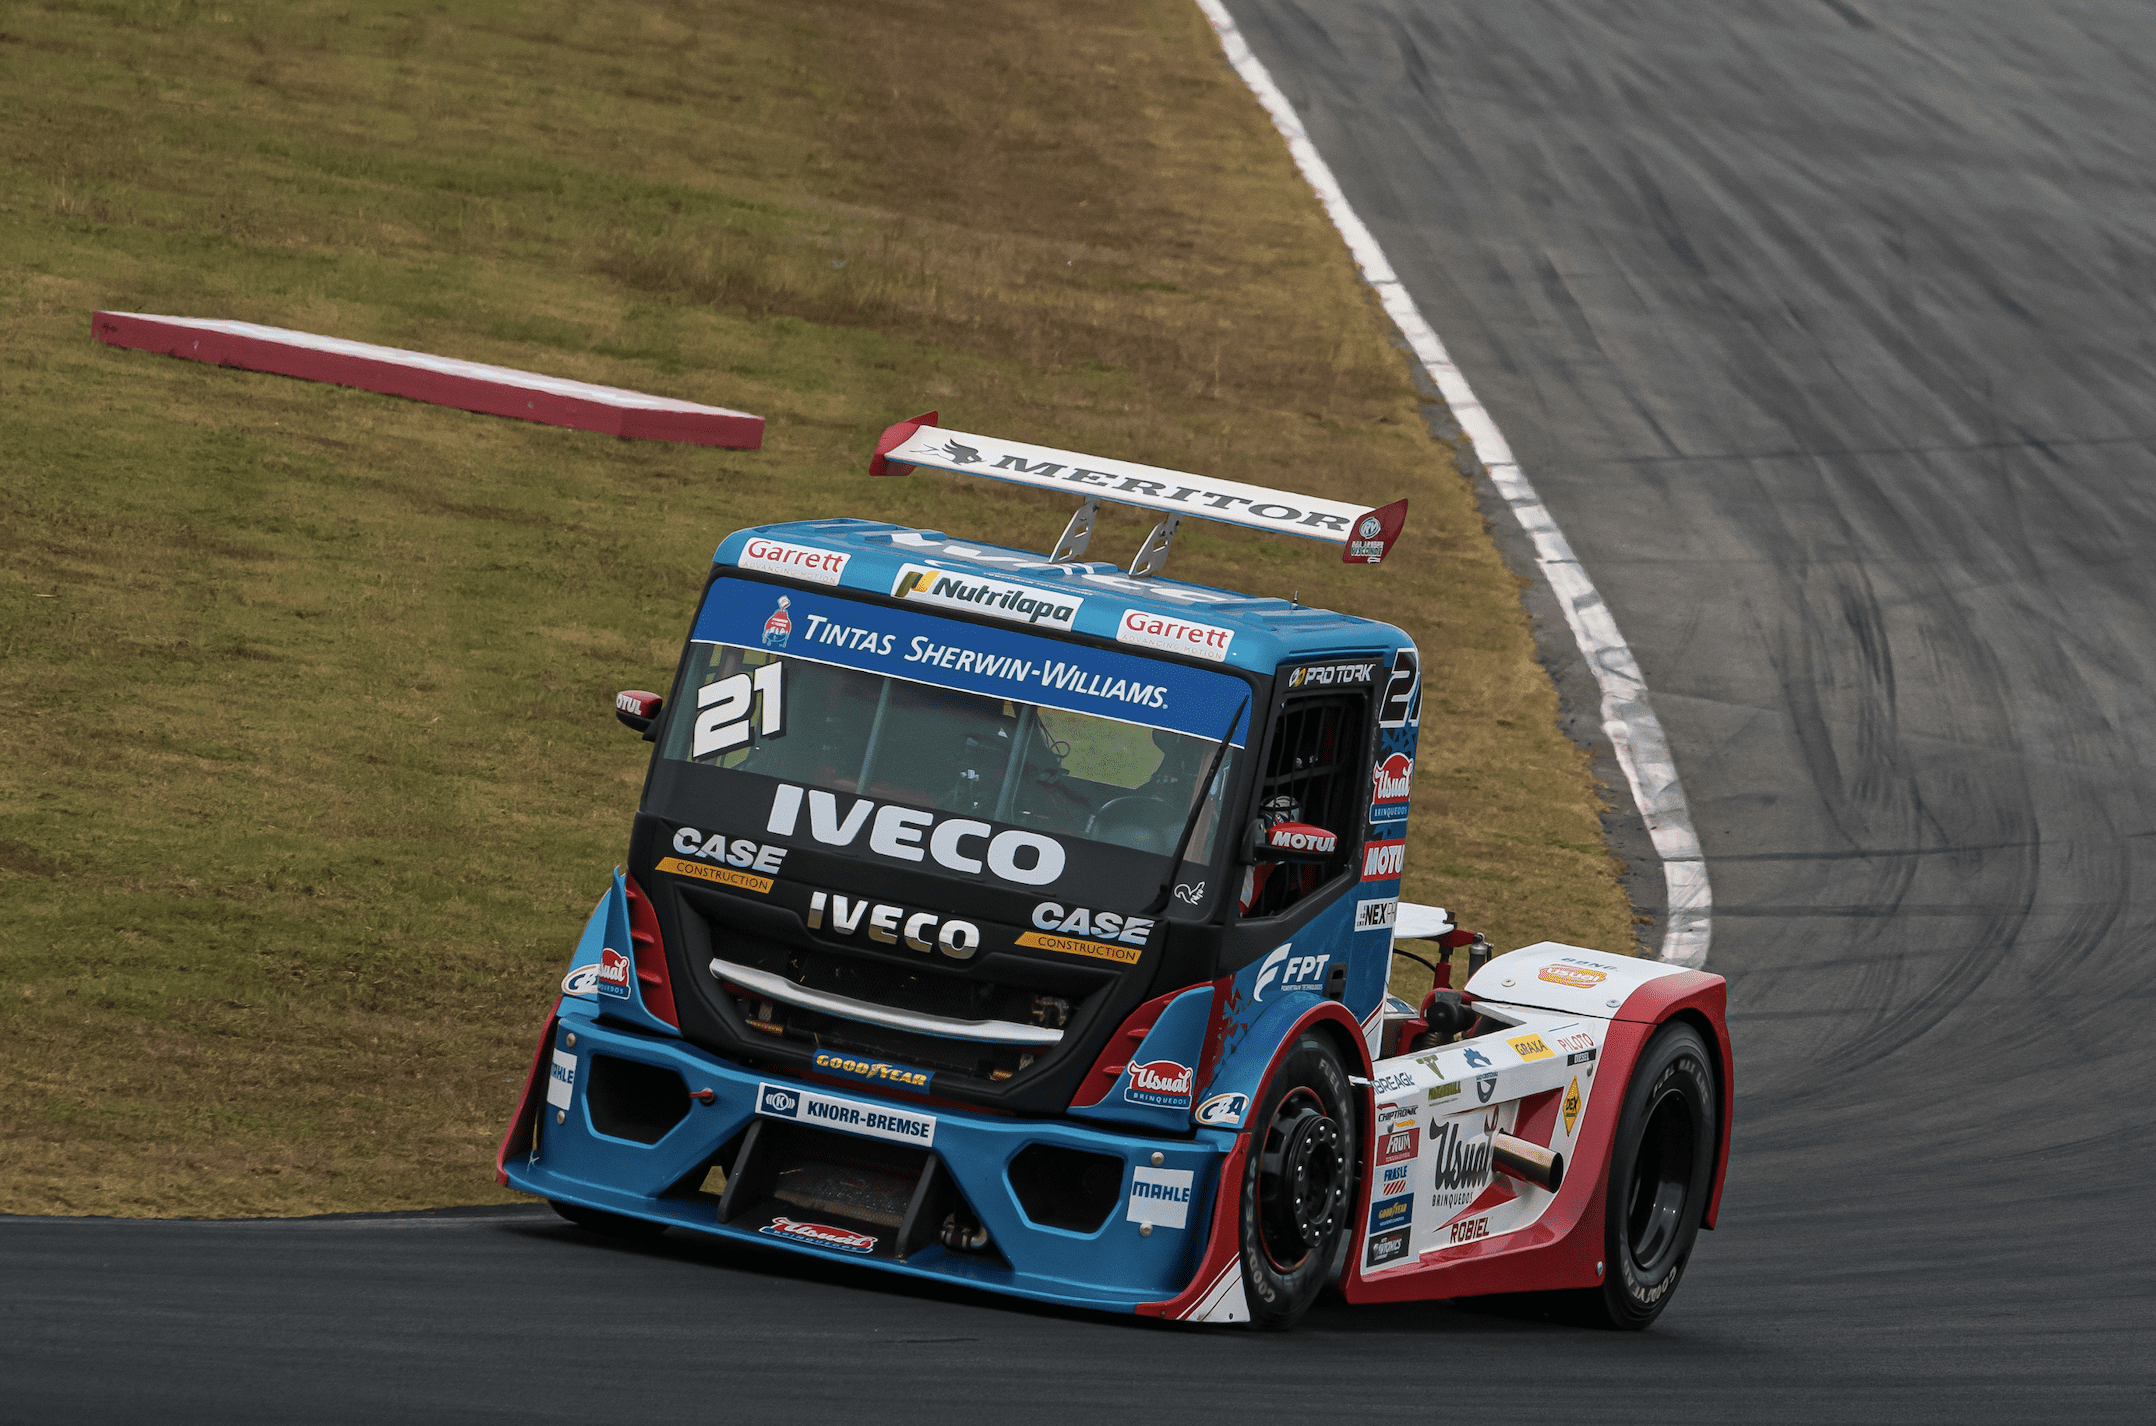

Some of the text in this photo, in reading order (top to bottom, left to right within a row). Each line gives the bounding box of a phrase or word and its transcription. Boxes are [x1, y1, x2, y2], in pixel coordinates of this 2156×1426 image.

[990, 455, 1350, 532] MERITOR
[743, 561, 836, 583] ADVANCING MOTION
[748, 541, 843, 573] Garrett
[932, 577, 1074, 624] Nutrilapa
[804, 614, 896, 655] TINTAS
[1126, 613, 1228, 649] Garrett
[1122, 634, 1223, 660] ADVANCING MOTION
[1304, 664, 1376, 685] PRO TORK
[616, 693, 642, 716] OTUL
[693, 661, 782, 758] 21
[1374, 761, 1413, 799] Usual
[766, 783, 1066, 886] IVECO
[1271, 830, 1335, 852] MOTUL
[672, 827, 788, 875] CASE
[1364, 844, 1405, 876] MOTU
[676, 862, 769, 890] CONSTRUCTION
[806, 891, 980, 959] IVECO
[1031, 902, 1155, 945] CASE
[1037, 936, 1136, 962] CONSTRUCTION
[1282, 954, 1331, 984] FPT
[1515, 1040, 1549, 1056] GRAXA
[1557, 1033, 1595, 1052] PILOTO
[816, 1055, 927, 1087] GOODYEAR
[1130, 1064, 1191, 1093] Usual
[1319, 1057, 1341, 1094] FUEL
[1133, 1092, 1187, 1106] BRINQUEDOS
[807, 1101, 930, 1138] KNORR-BREMSE
[1384, 1164, 1408, 1182] FRASLE
[1133, 1181, 1190, 1202] MAHLE
[1450, 1216, 1490, 1243] ROBIEL
